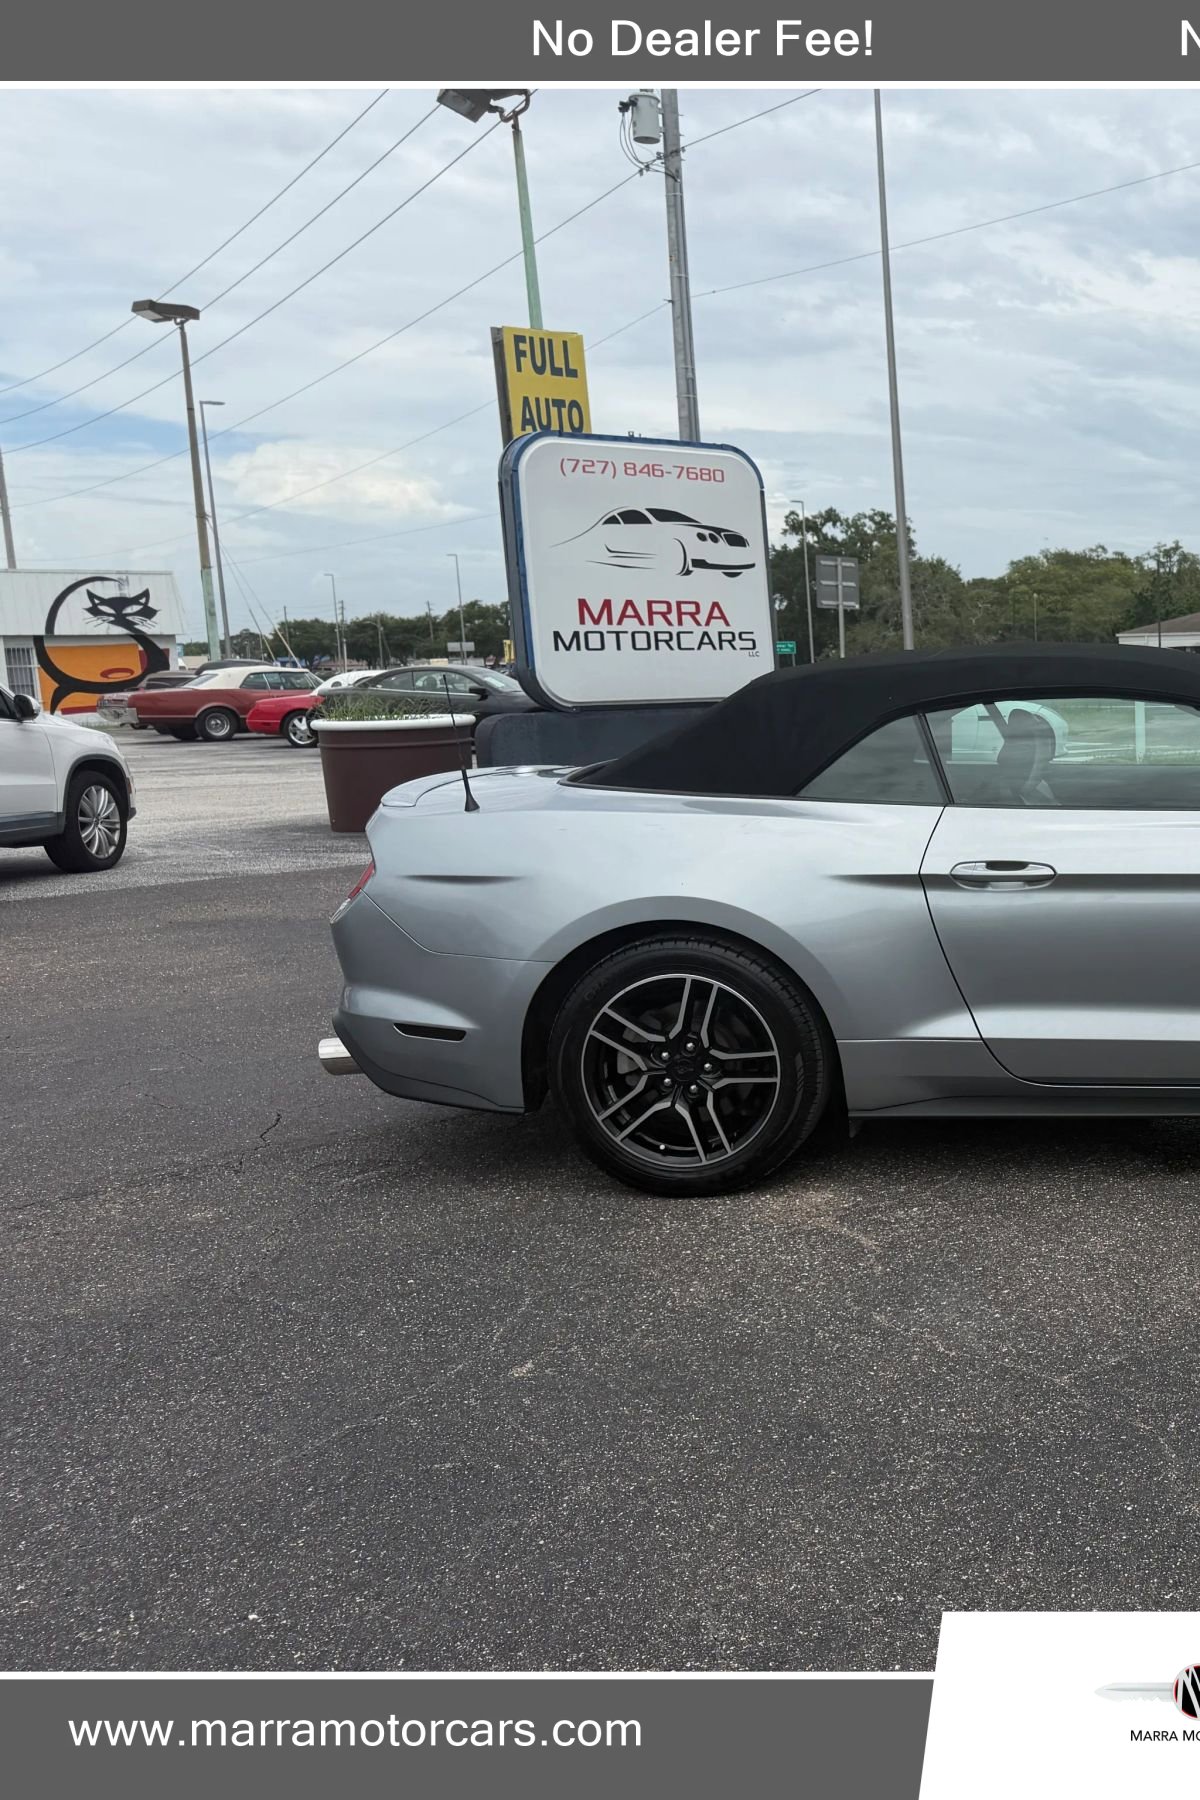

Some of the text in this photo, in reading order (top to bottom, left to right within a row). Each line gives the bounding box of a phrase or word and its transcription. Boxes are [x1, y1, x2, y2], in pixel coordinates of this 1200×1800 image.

[513, 334, 578, 378] FULL
[521, 396, 584, 433] AUTO
[560, 457, 725, 483] (727) 846-7680
[577, 598, 732, 627] MARRA
[552, 630, 757, 651] MOTORCARS
